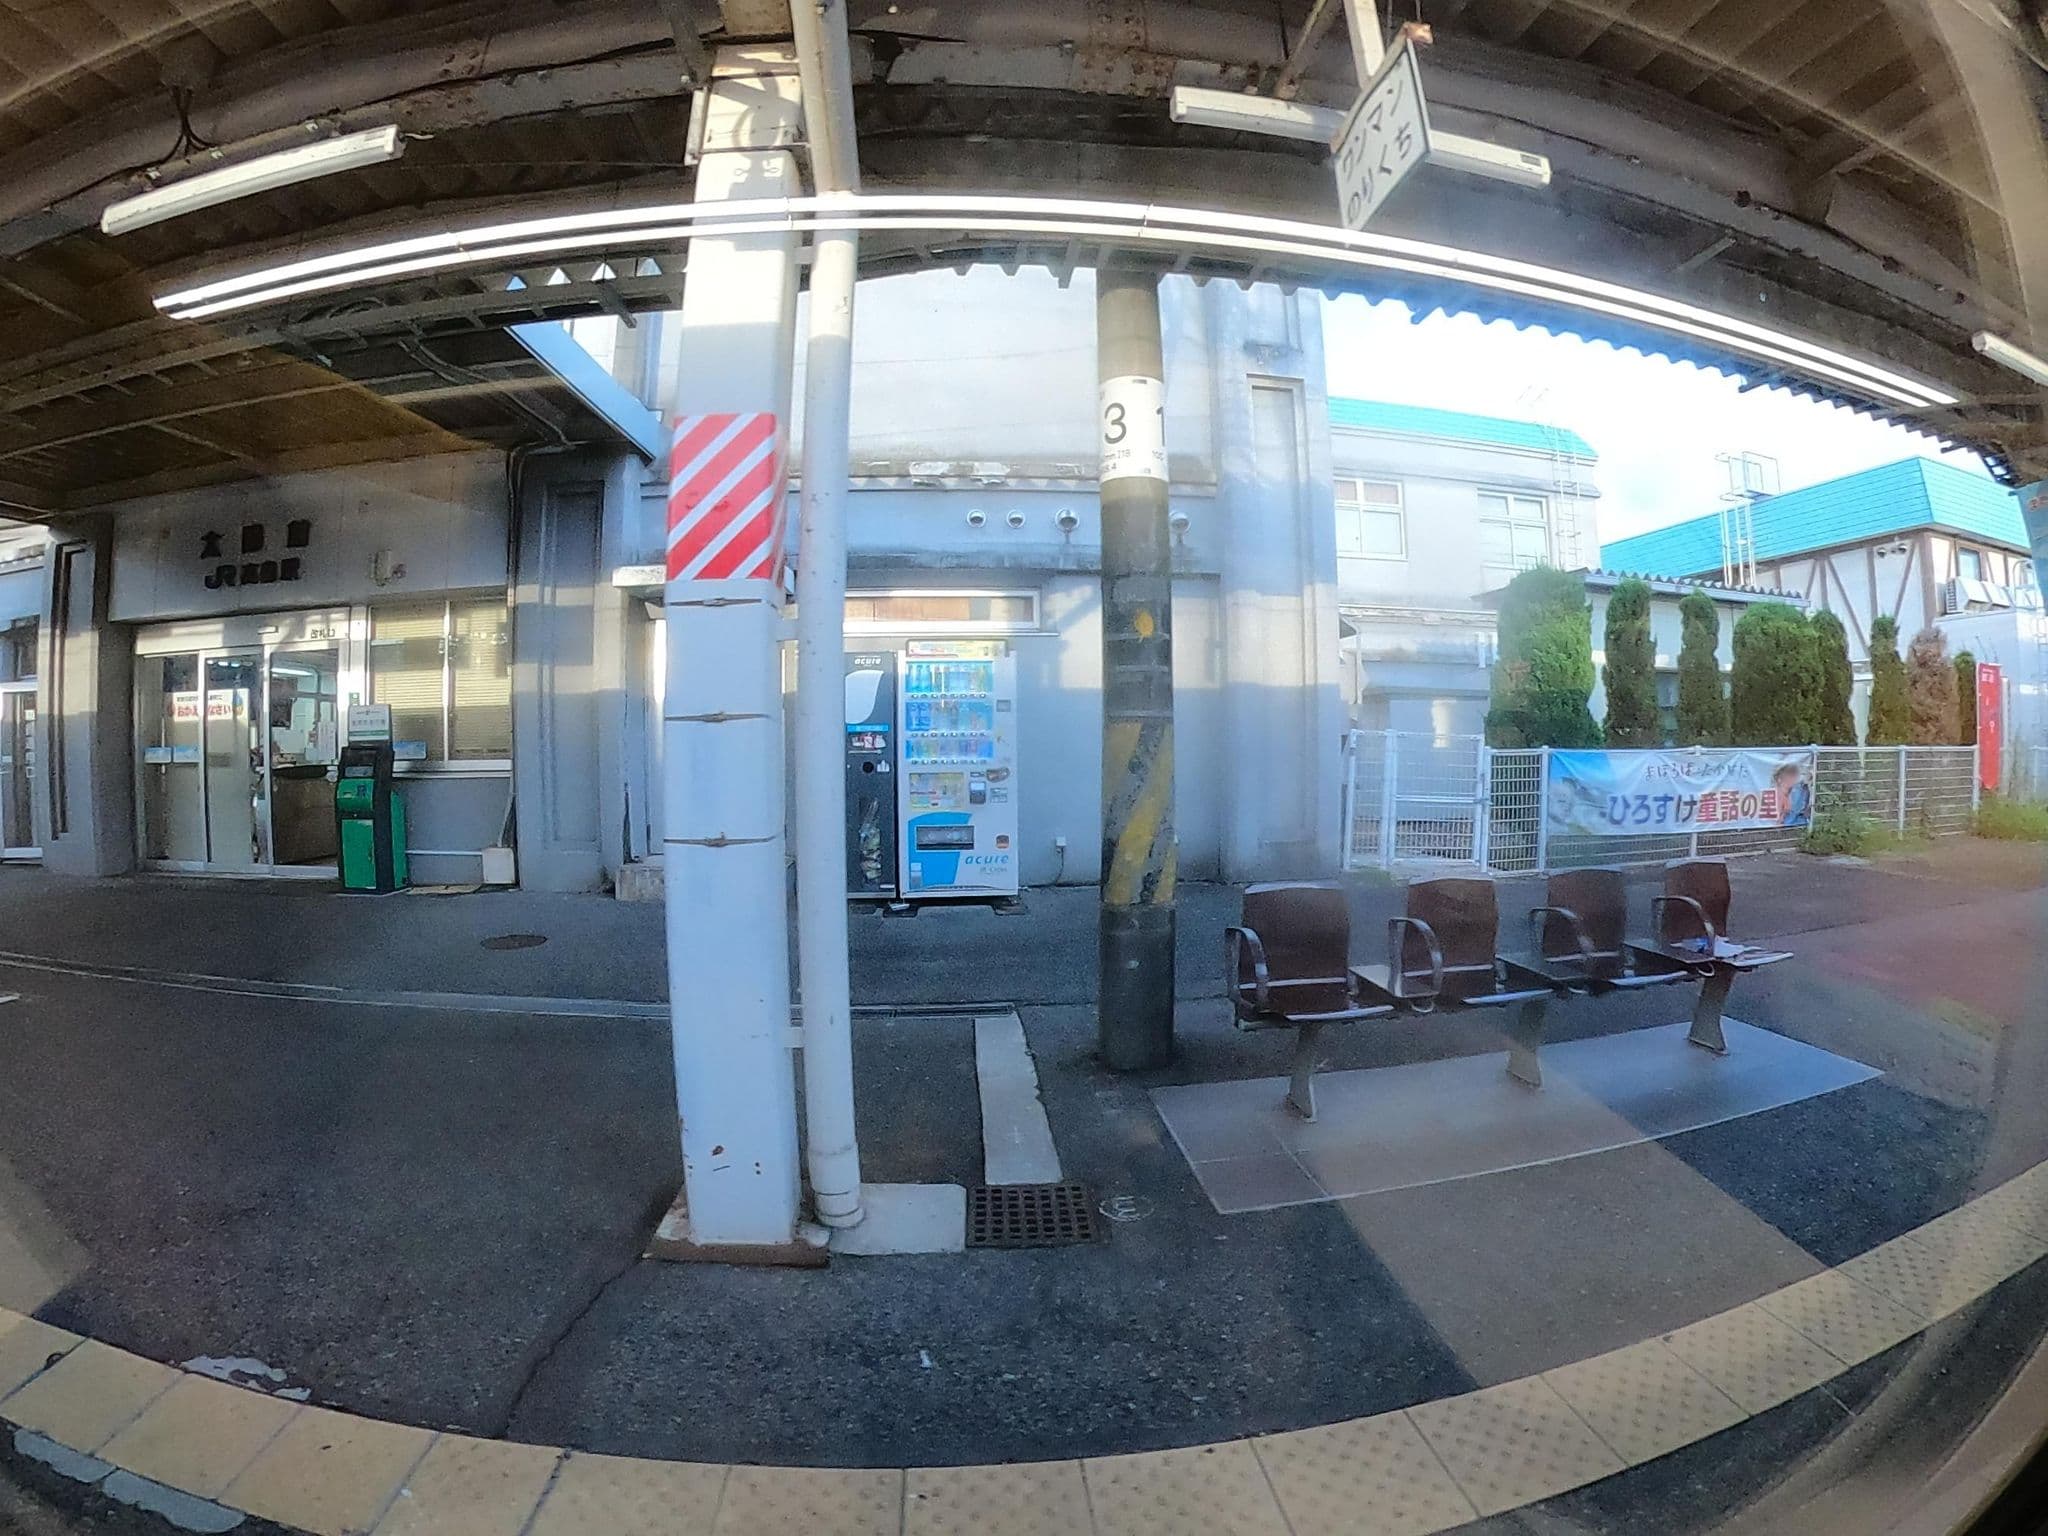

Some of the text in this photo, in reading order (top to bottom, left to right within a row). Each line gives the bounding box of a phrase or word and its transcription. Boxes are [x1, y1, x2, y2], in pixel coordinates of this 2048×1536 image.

[1104, 402, 1127, 445] 3
[1607, 788, 1778, 826] ひろすけ童話の里
[965, 854, 1009, 865] acure
